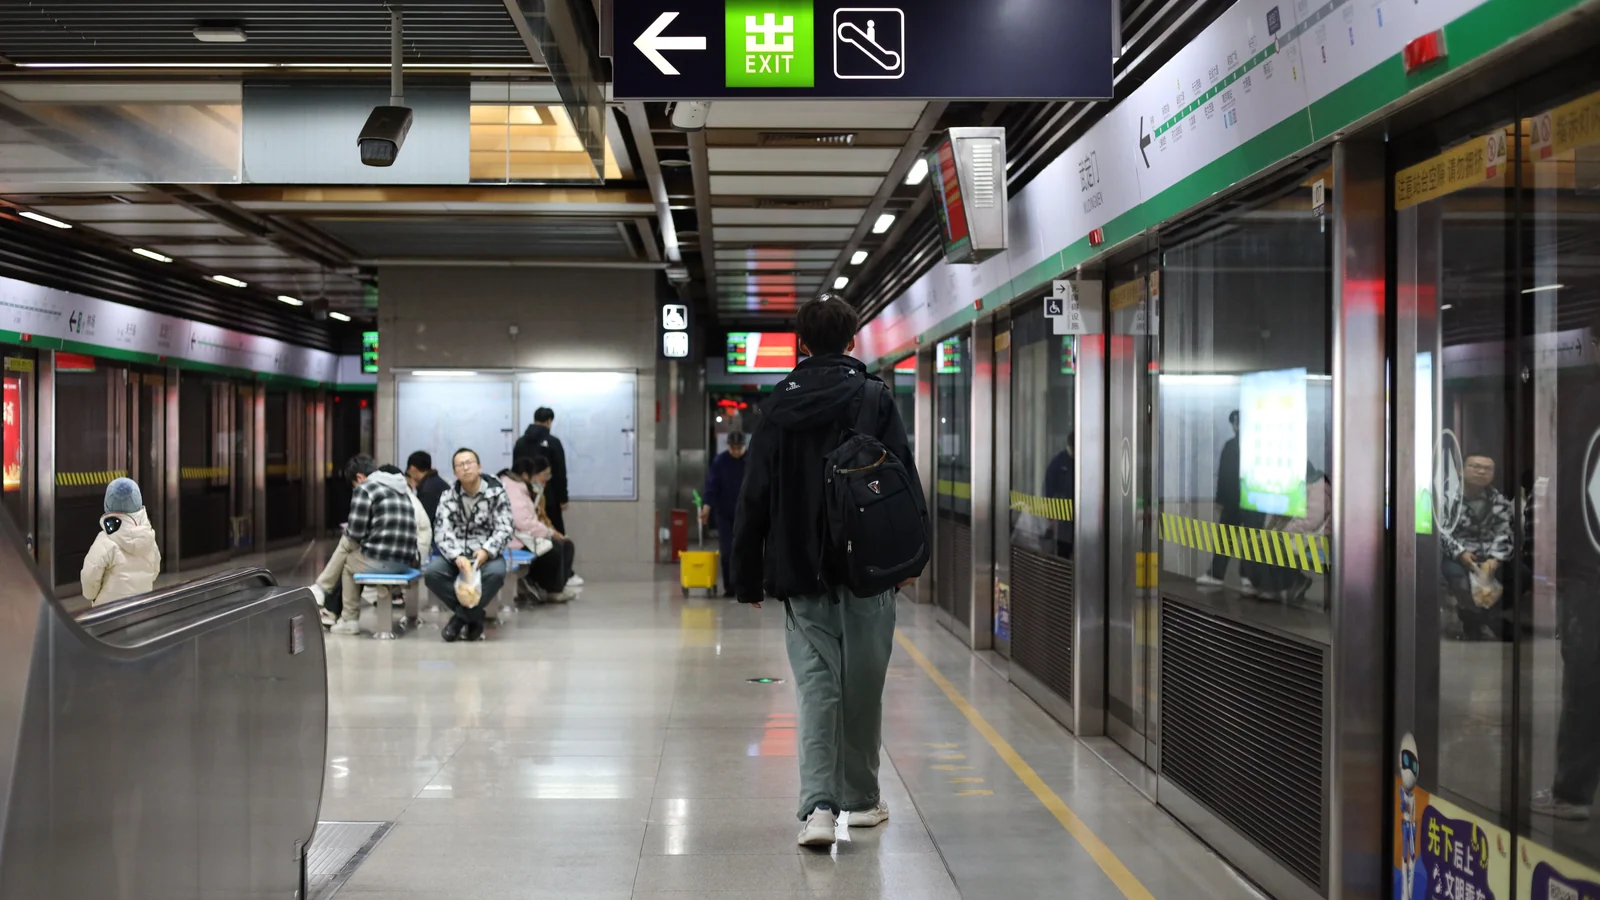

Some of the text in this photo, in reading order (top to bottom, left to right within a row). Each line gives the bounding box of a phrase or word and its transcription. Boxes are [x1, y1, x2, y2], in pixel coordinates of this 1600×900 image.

[745, 55, 794, 74] EXIT
[1427, 817, 1474, 877] 先下后上
